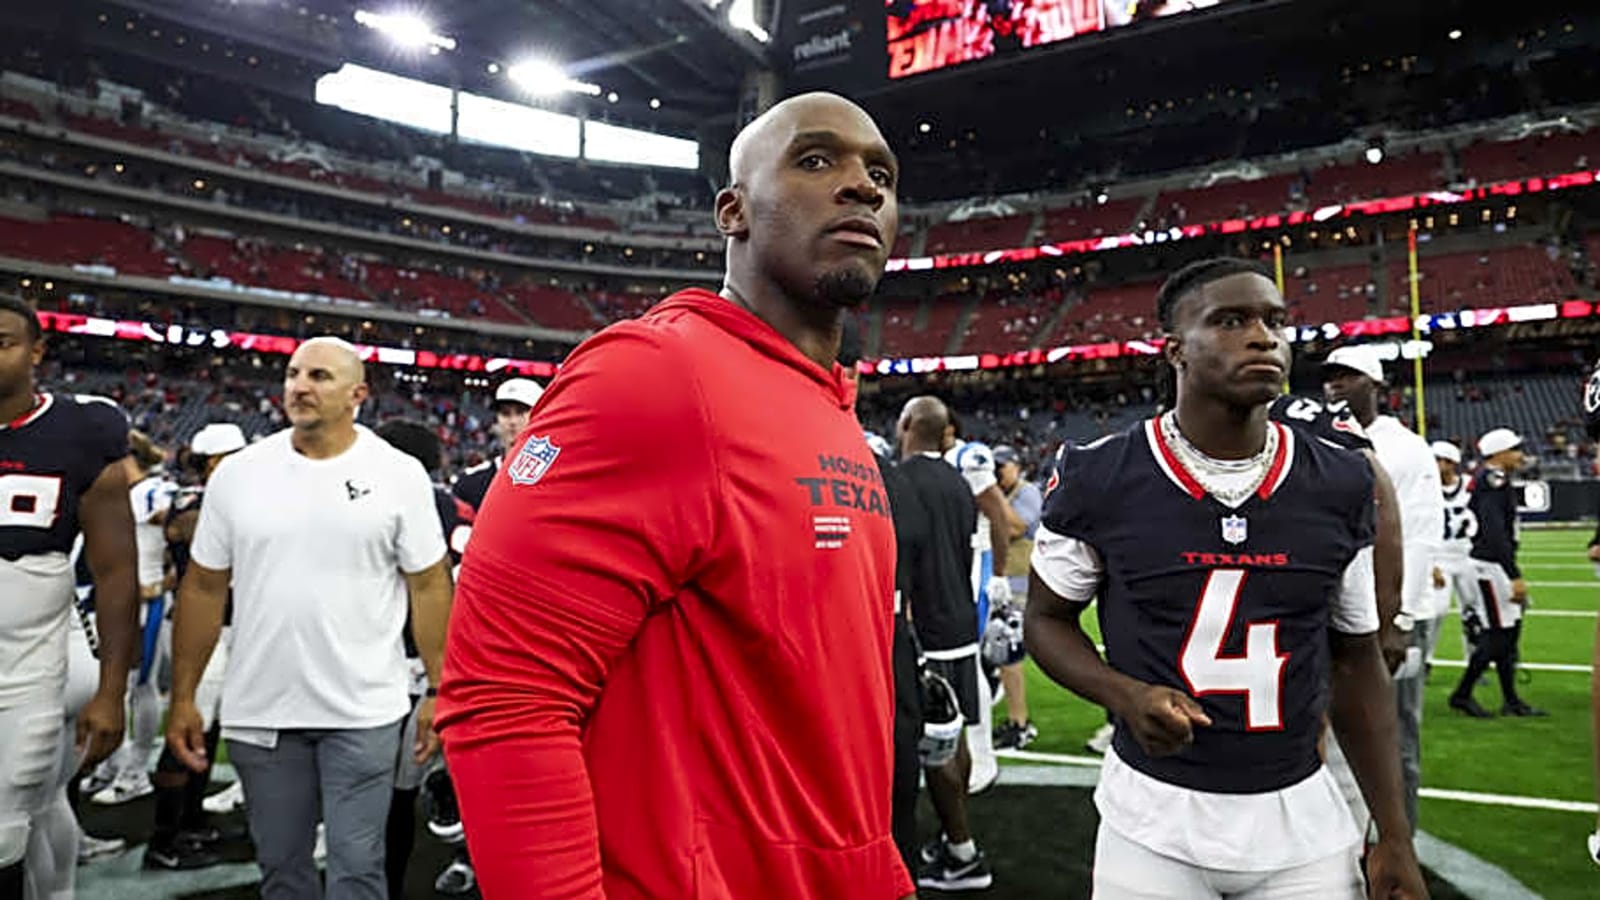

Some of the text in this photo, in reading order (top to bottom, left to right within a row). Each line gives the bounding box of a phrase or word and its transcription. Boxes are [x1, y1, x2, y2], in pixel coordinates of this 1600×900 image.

[513, 454, 541, 479] NFL
[817, 453, 880, 483] HOUST
[1181, 551, 1290, 565] TEXANS
[1178, 567, 1292, 731] 4
